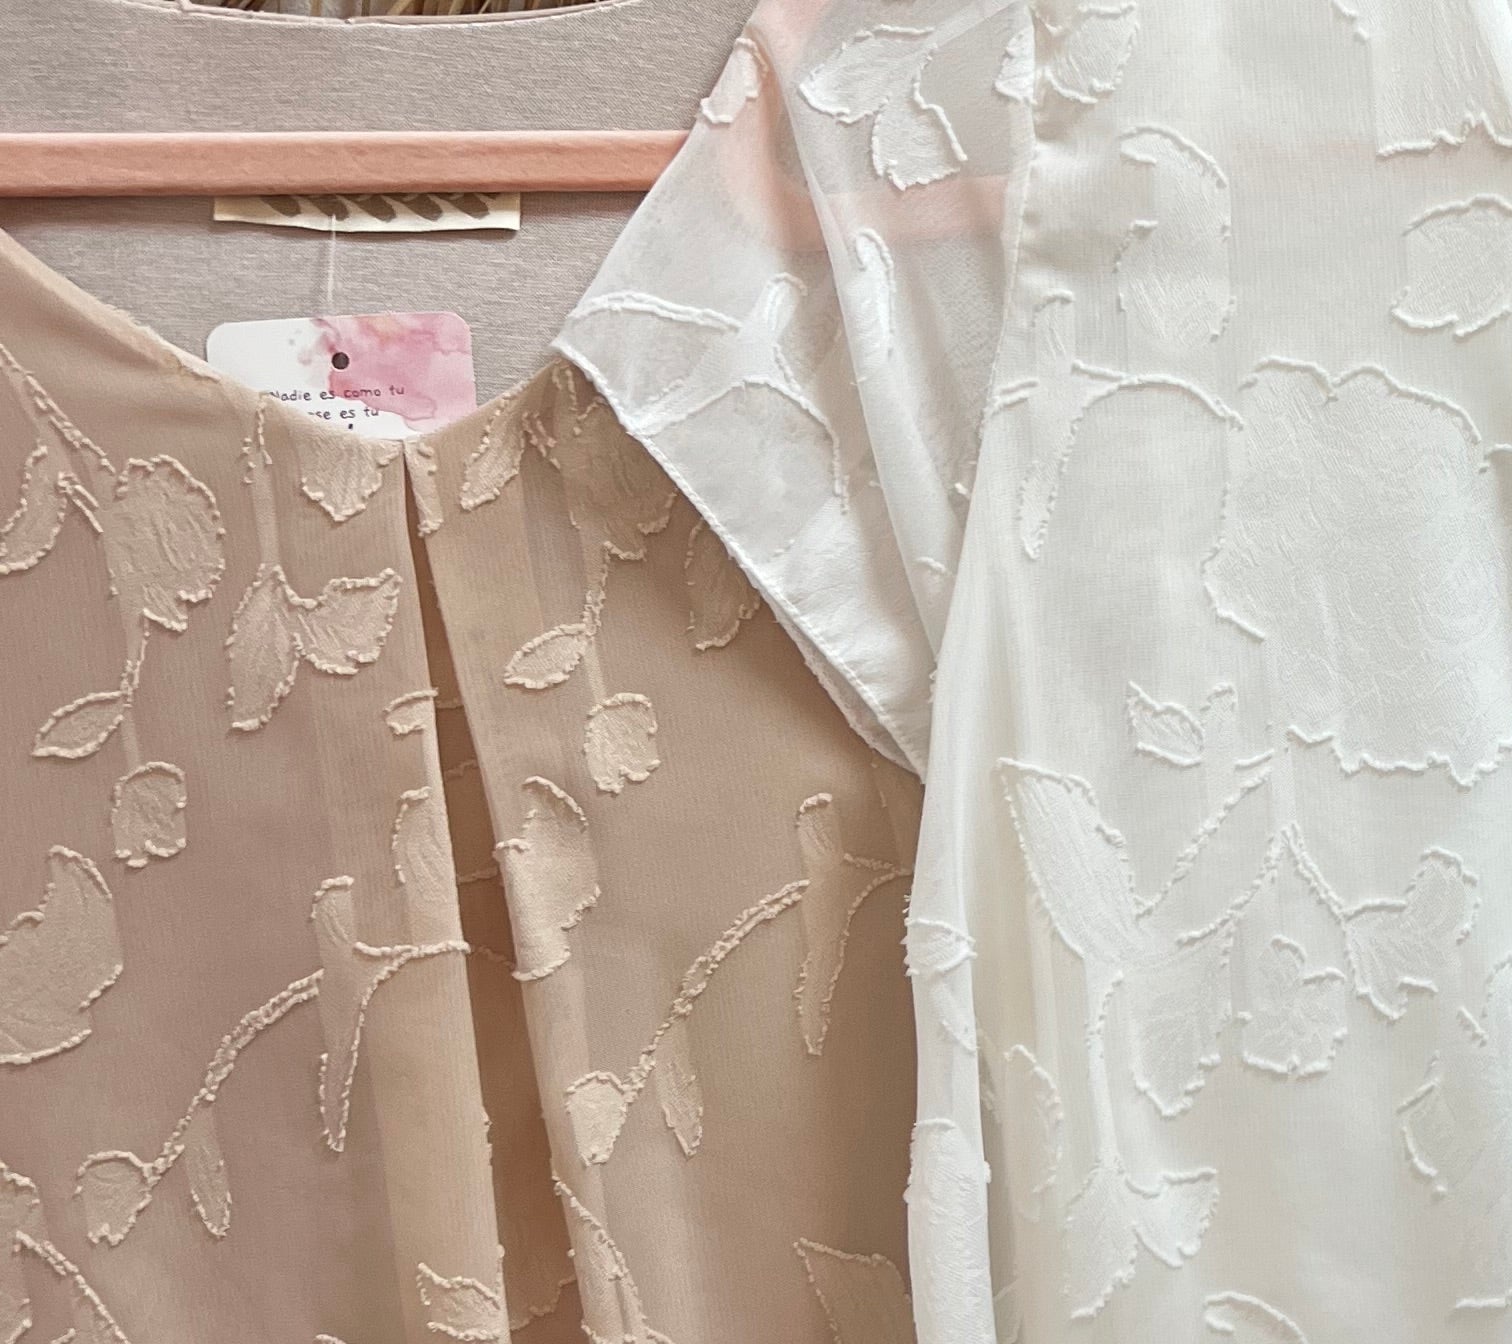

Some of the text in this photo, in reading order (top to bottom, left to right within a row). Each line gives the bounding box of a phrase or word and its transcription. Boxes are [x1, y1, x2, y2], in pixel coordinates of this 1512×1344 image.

[319, 390, 336, 400] es
[343, 389, 381, 399] como
[388, 385, 405, 396] tu
[339, 408, 356, 419] es
[363, 406, 379, 417] tu
